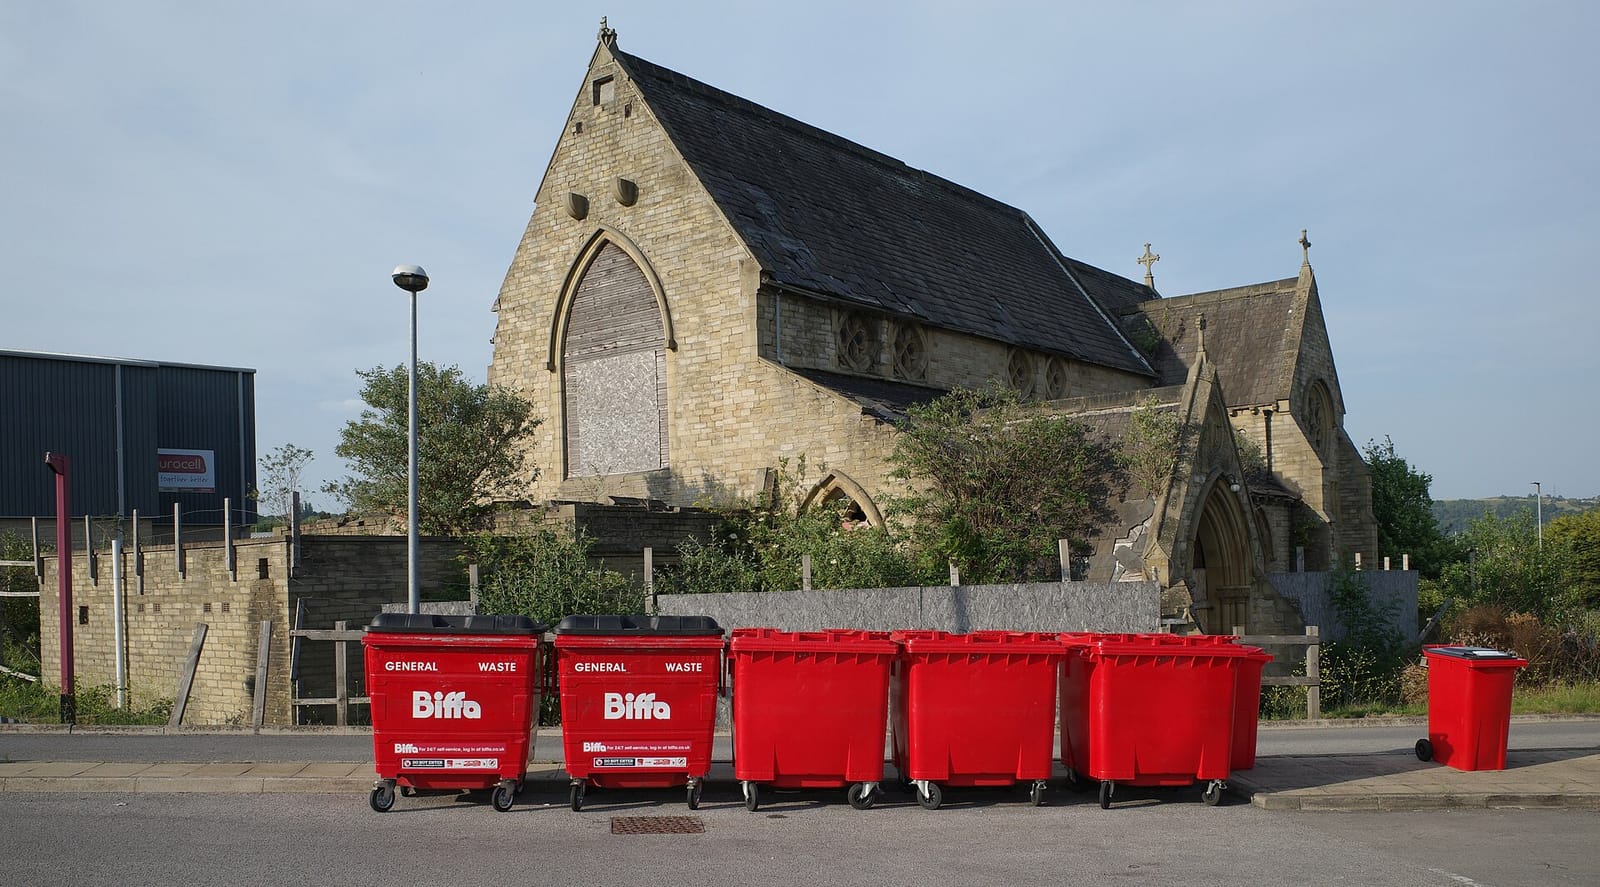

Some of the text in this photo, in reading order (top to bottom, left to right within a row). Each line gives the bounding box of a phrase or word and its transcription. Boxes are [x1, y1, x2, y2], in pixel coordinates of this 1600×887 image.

[159, 458, 201, 470] urocell
[385, 661, 517, 672] GENERAL WASTE
[574, 662, 703, 672] GENERAL WASTE
[412, 690, 481, 719] Biffa
[604, 692, 671, 720] Biffa
[394, 743, 419, 754] Biffa
[583, 742, 607, 752] Biffa
